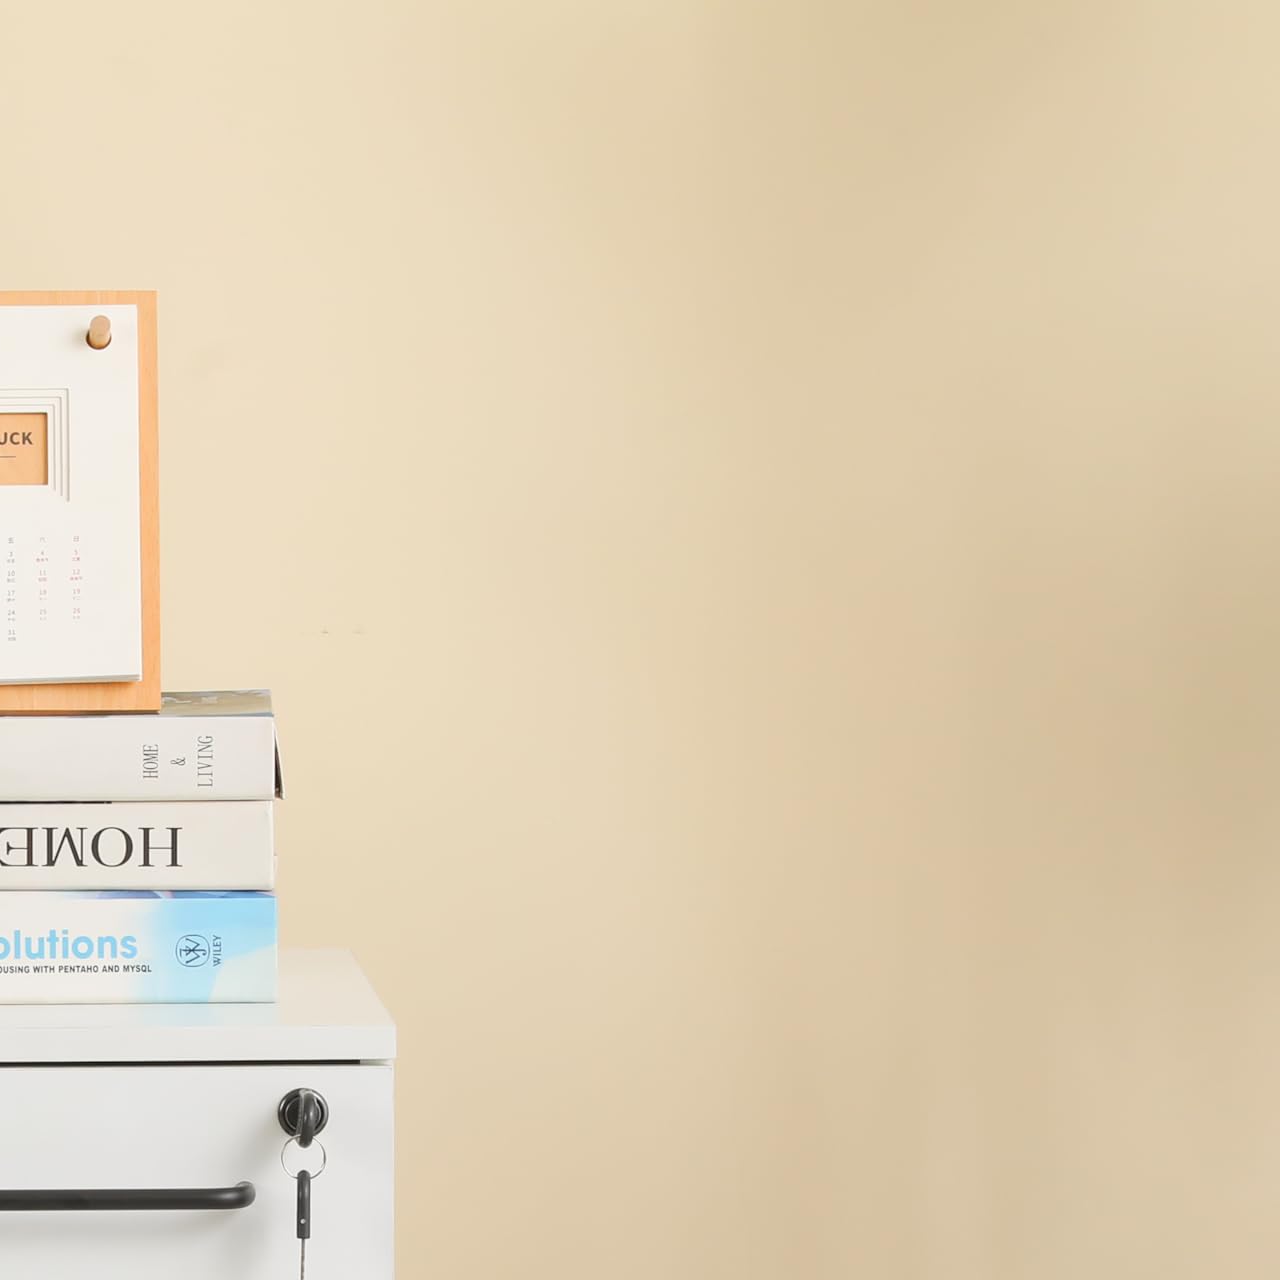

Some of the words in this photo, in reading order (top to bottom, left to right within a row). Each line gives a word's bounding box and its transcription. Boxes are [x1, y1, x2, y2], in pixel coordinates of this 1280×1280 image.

[142, 743, 159, 779] HOME
[169, 756, 186, 767] &
[196, 735, 214, 788] LIVING
[212, 934, 222, 967] WILEY
[32, 965, 56, 974] WITH
[58, 964, 99, 974] PENTAHO
[101, 964, 120, 973] AND
[122, 964, 153, 973] MYSQL
